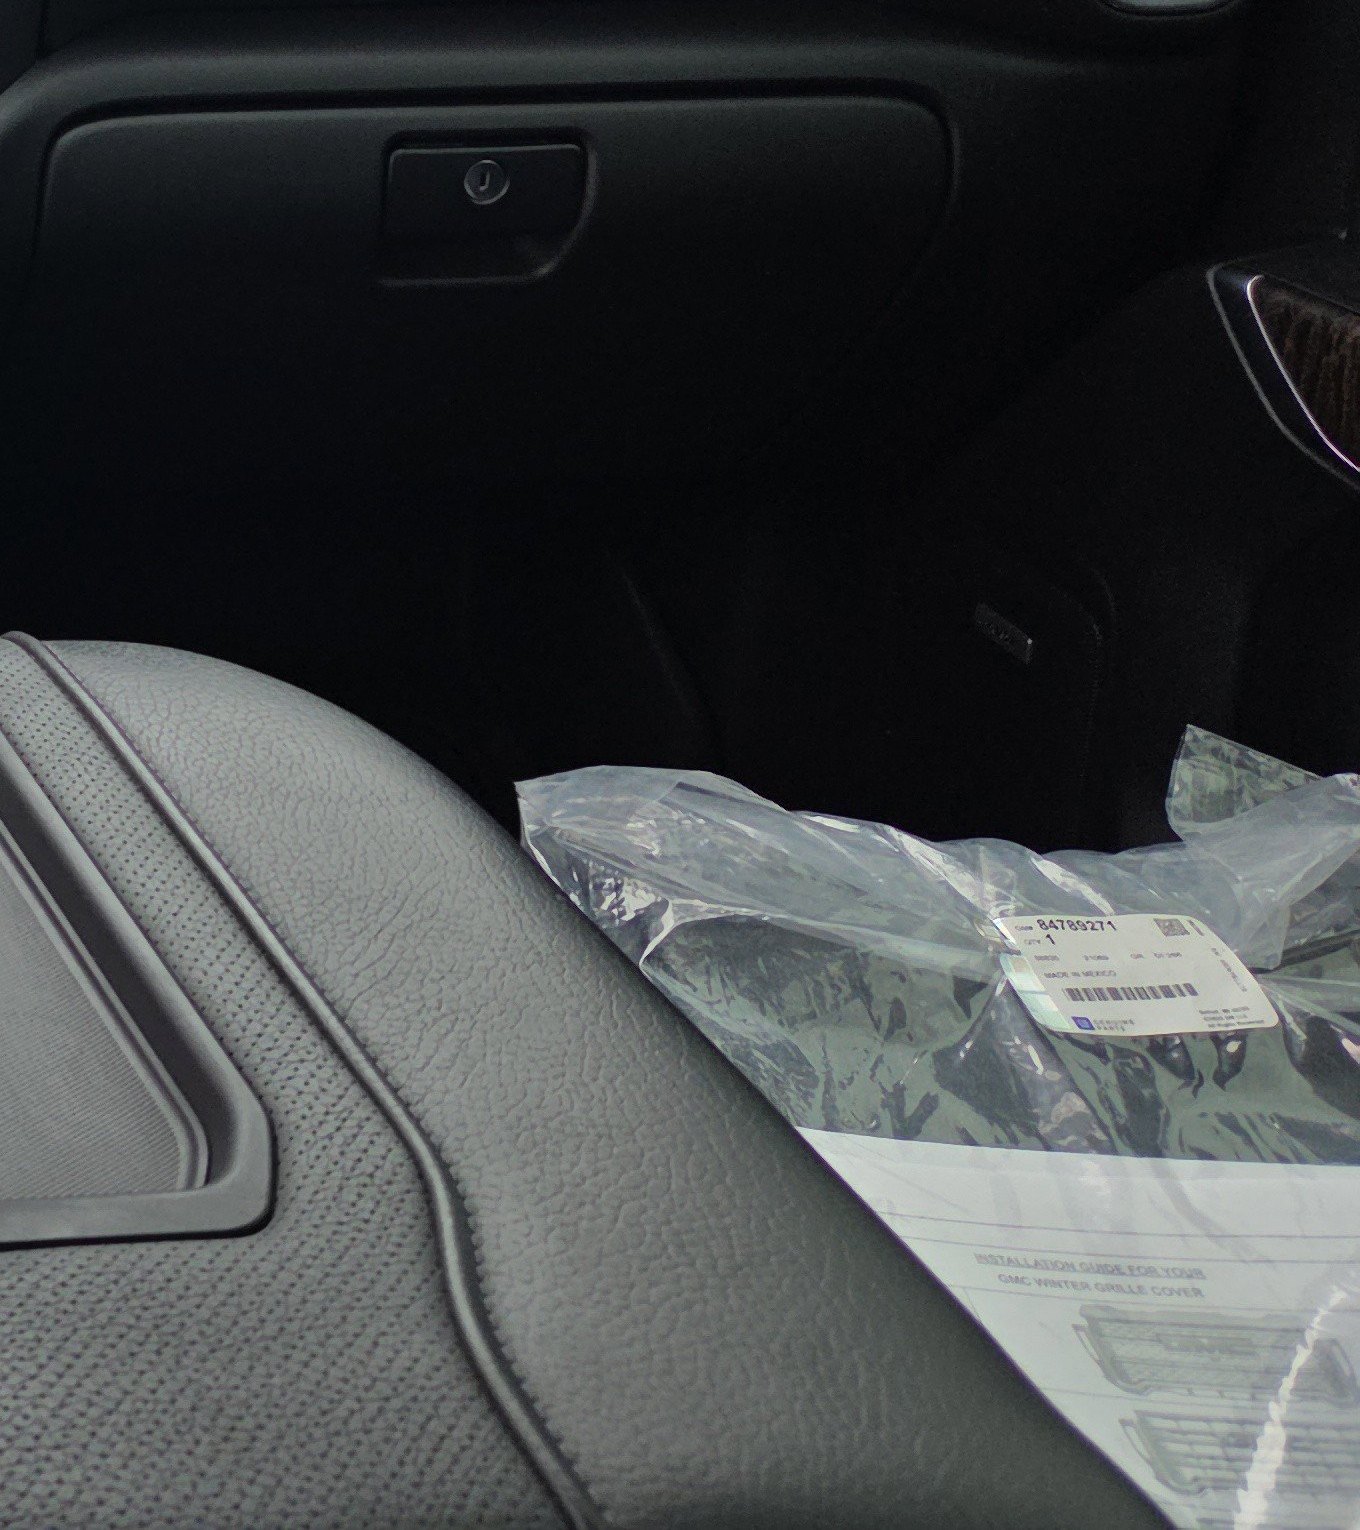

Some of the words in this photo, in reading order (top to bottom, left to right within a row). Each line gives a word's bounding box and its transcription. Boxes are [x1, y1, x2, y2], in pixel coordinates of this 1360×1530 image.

[974, 1252, 1075, 1272] INSTALLATION
[1128, 1265, 1159, 1279] FOR
[997, 1273, 1032, 1287] GMC
[1034, 1276, 1092, 1292] WINTER
[1094, 1281, 1145, 1296] GRILLE
[1151, 1284, 1206, 1298] COVER
